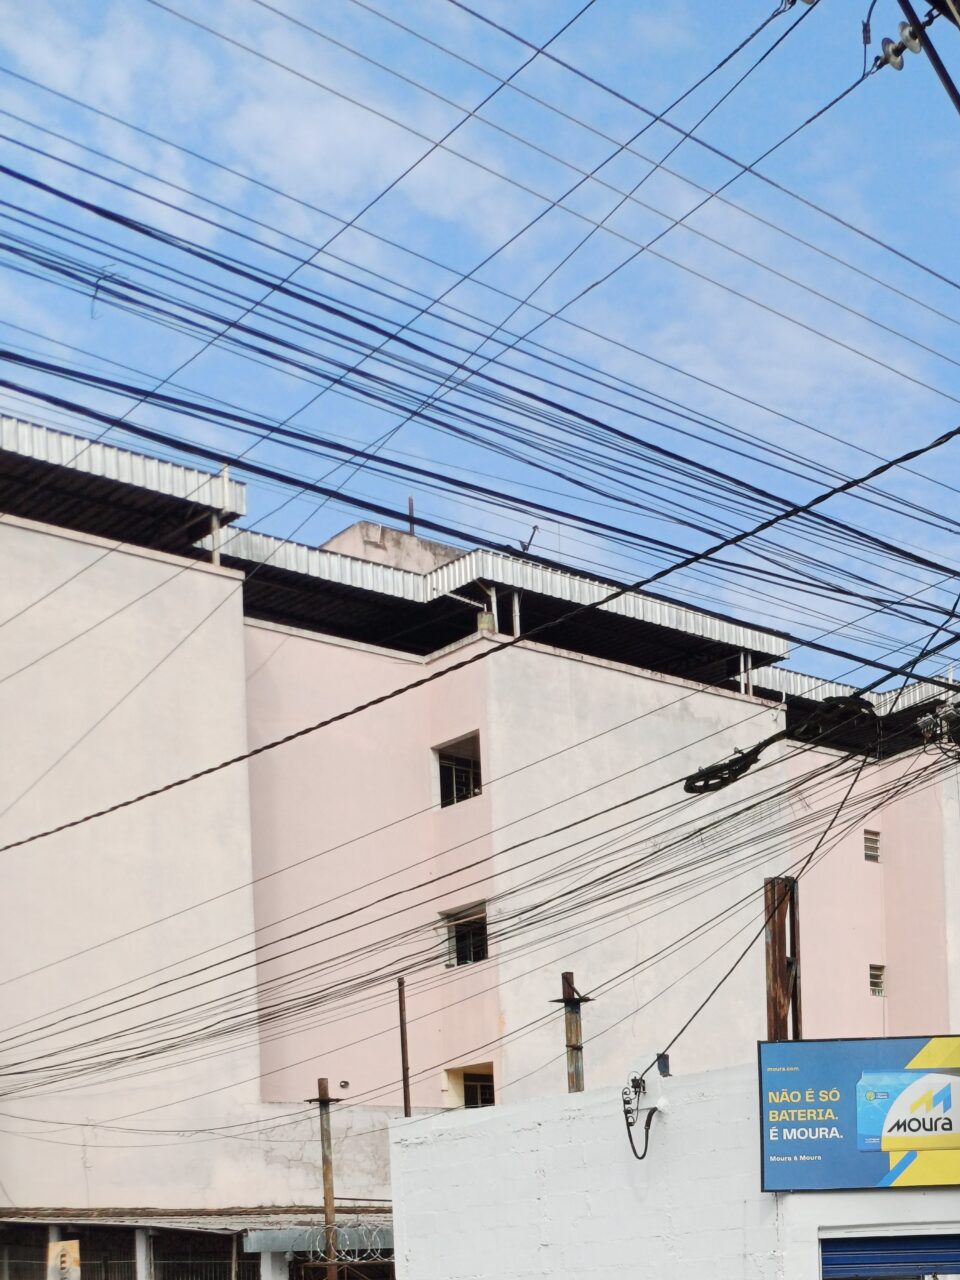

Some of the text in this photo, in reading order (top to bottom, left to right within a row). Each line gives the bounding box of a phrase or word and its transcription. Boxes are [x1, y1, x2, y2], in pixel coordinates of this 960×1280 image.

[768, 1087, 841, 1103] NÃO É SÓ
[768, 1109, 839, 1122] BATERIA.
[769, 1127, 844, 1141] É MOURA.
